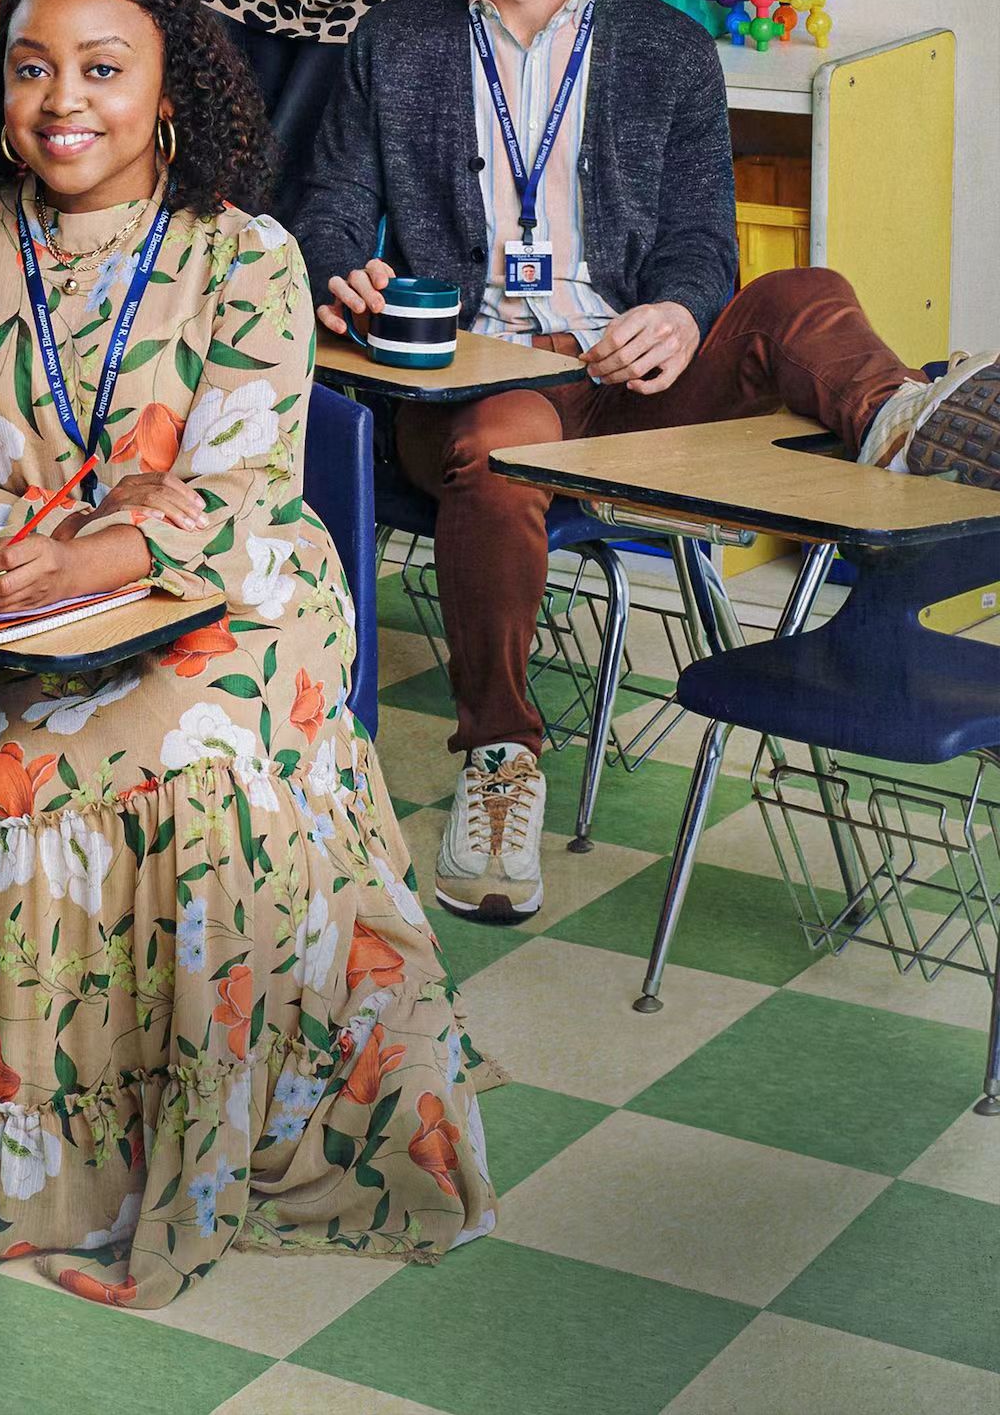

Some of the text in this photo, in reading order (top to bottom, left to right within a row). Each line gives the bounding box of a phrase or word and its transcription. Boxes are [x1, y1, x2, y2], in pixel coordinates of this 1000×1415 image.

[573, 30, 587, 52] Willard
[581, 22, 589, 30] R.
[492, 81, 523, 178] Willard R. Abbott Elementary
[534, 76, 573, 170] Willard R. Abbott Elementary
[24, 248, 36, 277] Willard
[140, 208, 169, 274] Abbott Elementary
[37, 304, 71, 422] Willard R. Abbott Elementary
[96, 300, 138, 419] Willard R. Abbott Elementary
